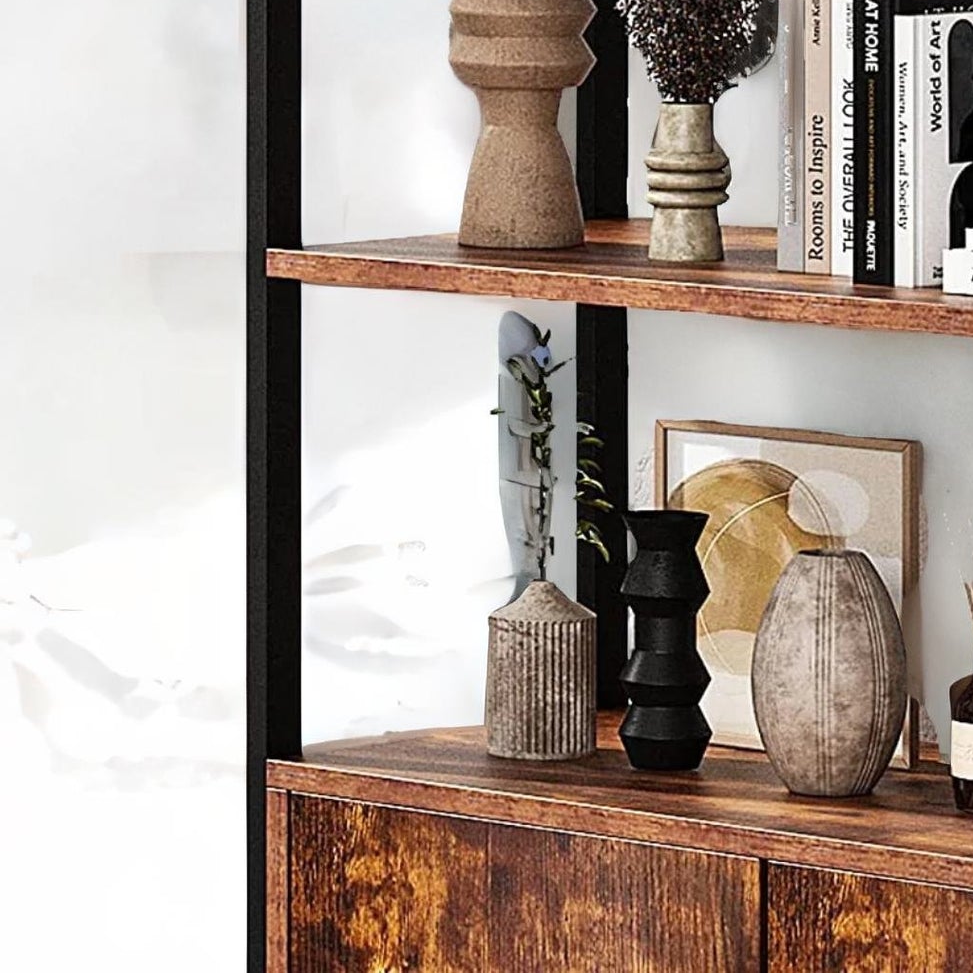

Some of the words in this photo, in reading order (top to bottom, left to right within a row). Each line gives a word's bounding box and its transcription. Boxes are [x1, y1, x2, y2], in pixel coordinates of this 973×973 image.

[812, 19, 822, 46] Annie
[864, 23, 879, 73] HOME
[930, 20, 942, 48] Art
[929, 53, 942, 73] of
[842, 79, 854, 128] LOOK
[898, 61, 908, 118] Women,
[930, 77, 943, 132] World
[807, 114, 827, 174] Inspire
[898, 150, 909, 176] and
[809, 178, 824, 196] to
[842, 137, 854, 213] OVERALL
[898, 179, 910, 230] Society
[808, 200, 824, 261] Rooms
[842, 218, 854, 253] THE
[866, 219, 876, 271] PAQUETTE
